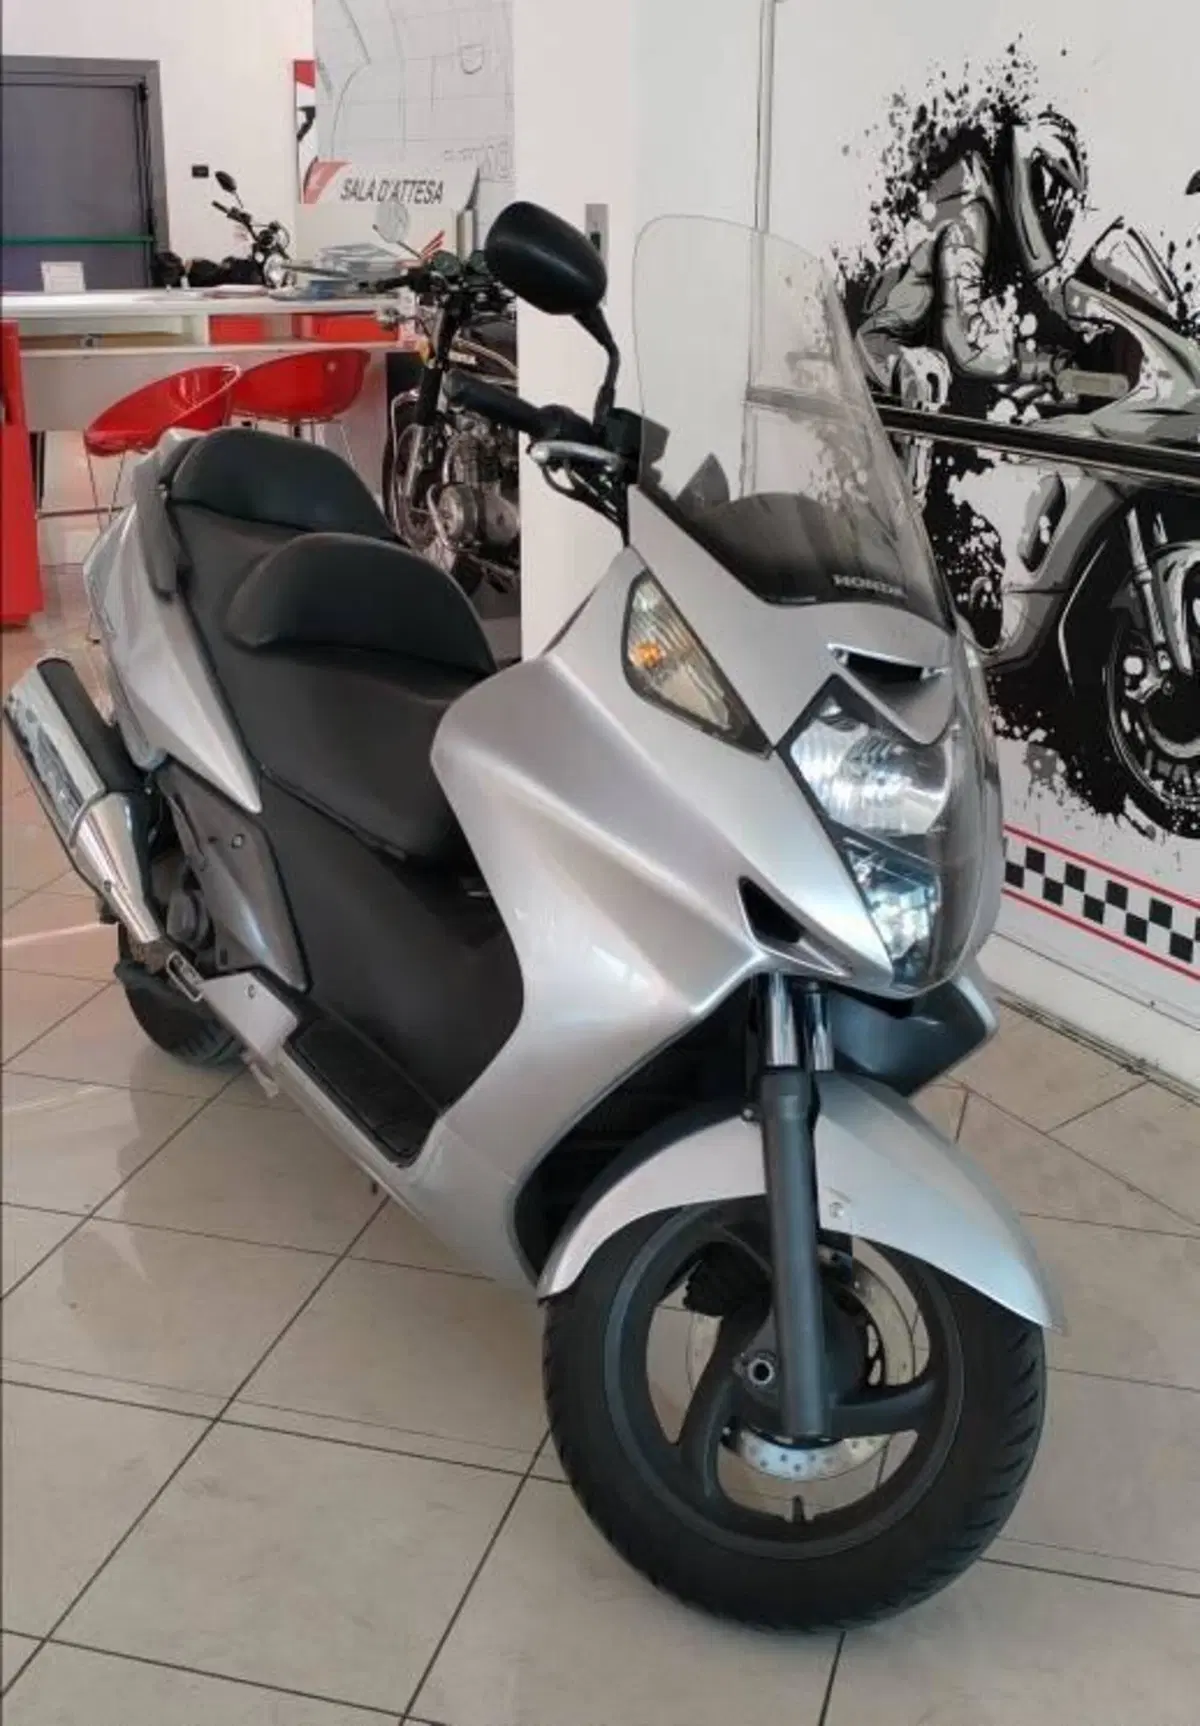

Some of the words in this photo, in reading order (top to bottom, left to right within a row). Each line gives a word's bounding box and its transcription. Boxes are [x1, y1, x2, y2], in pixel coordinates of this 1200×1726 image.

[340, 177, 376, 202] SALA
[377, 178, 444, 204] D'ATTESA
[832, 574, 906, 597] HONDA
